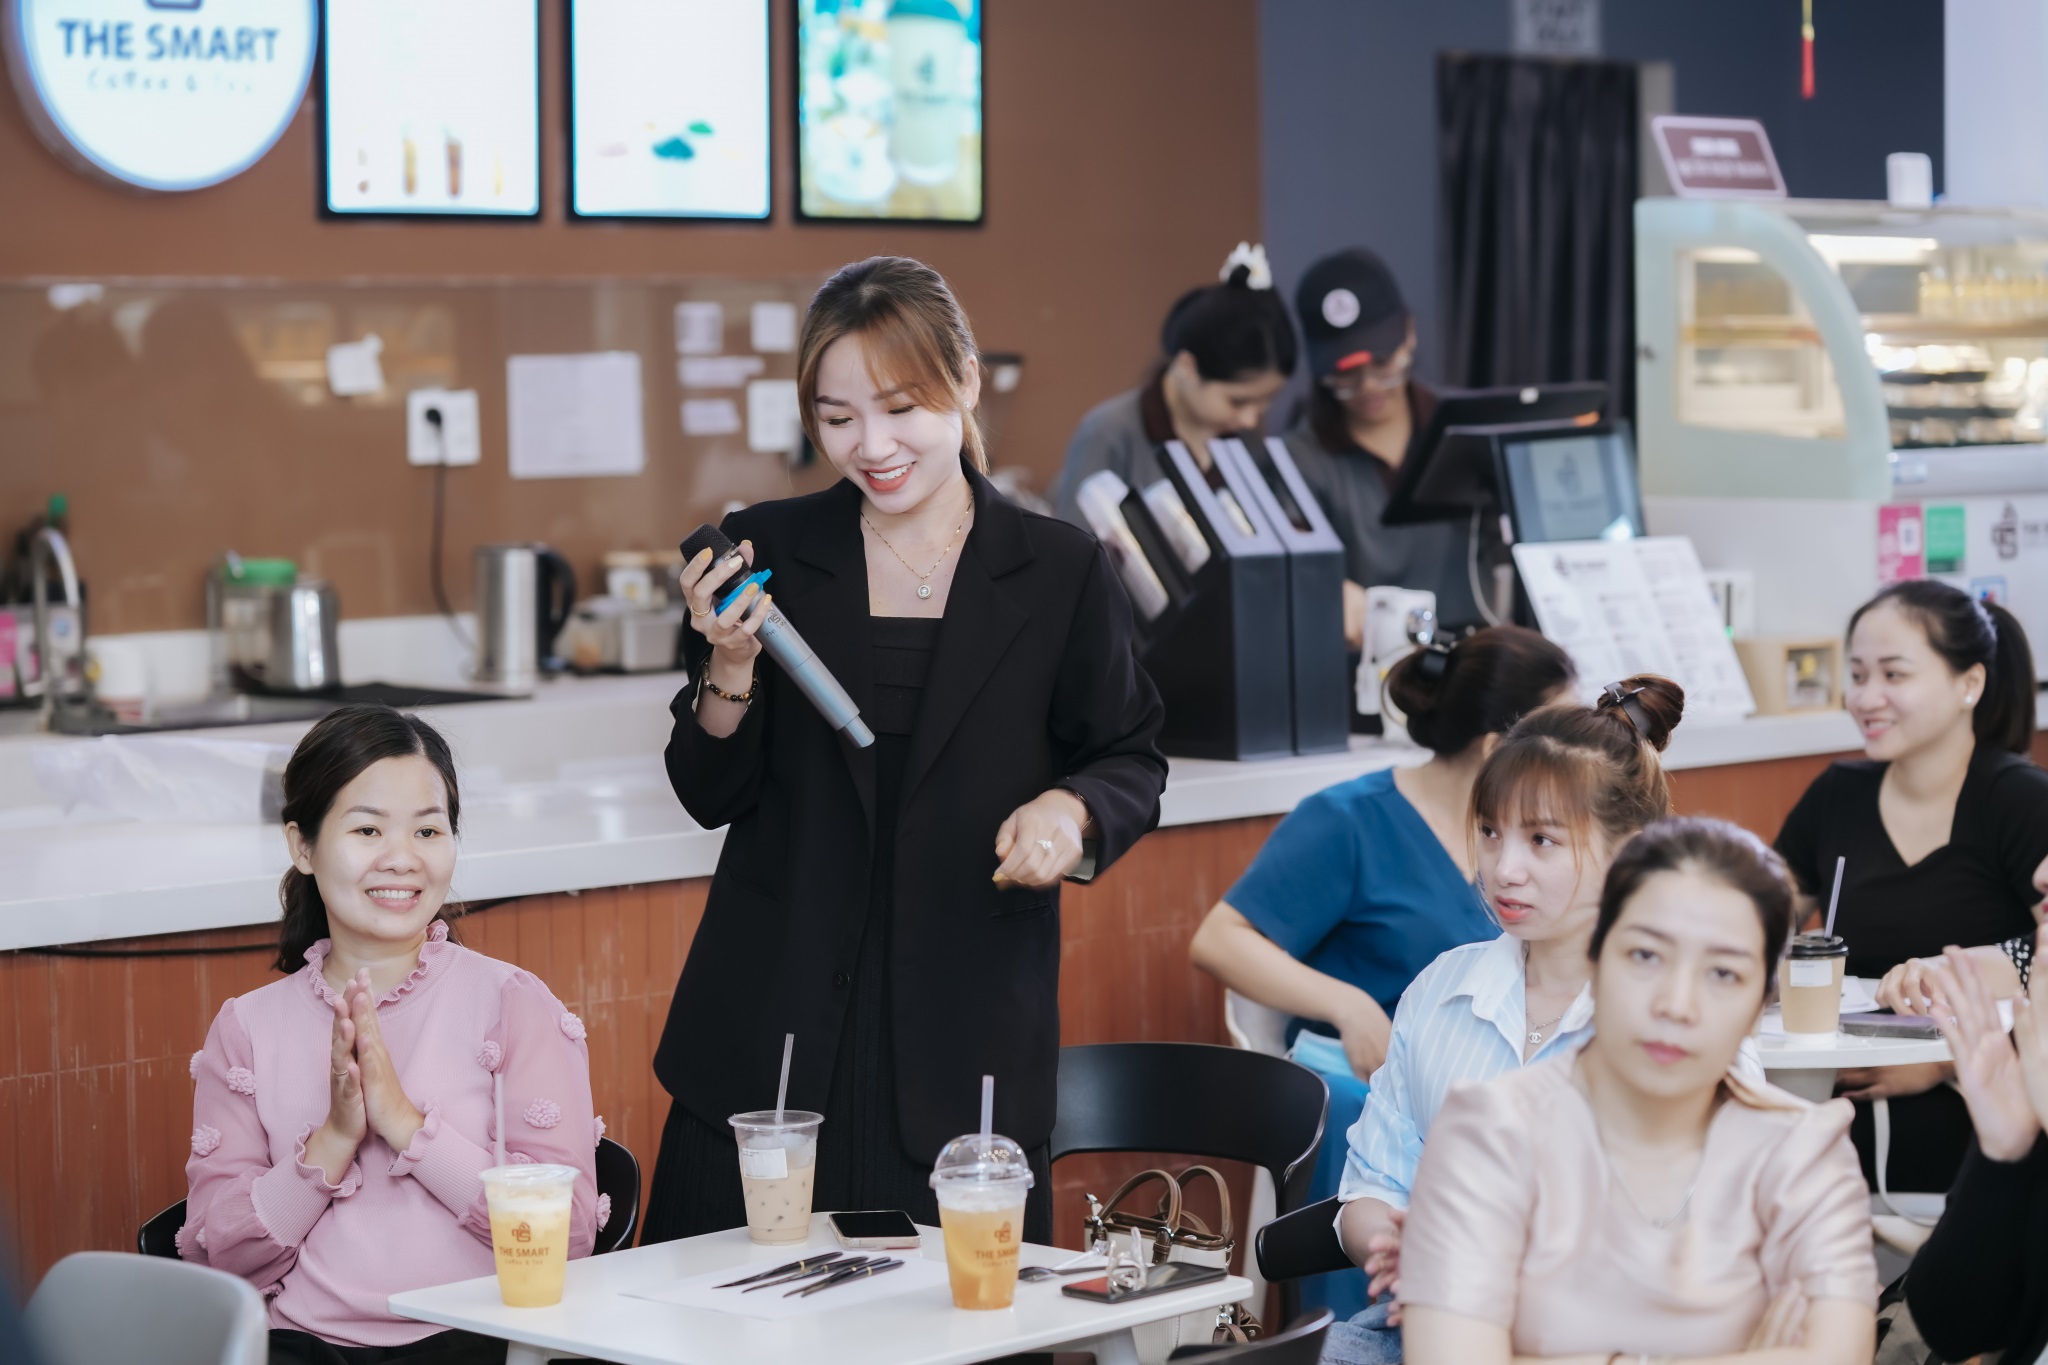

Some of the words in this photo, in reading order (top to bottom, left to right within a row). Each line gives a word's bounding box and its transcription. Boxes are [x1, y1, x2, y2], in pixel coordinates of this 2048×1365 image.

[57, 19, 134, 60] THE
[146, 23, 279, 62] SMART
[499, 1246, 513, 1257] THE
[516, 1247, 550, 1257] SMART
[975, 1249, 993, 1259] THE
